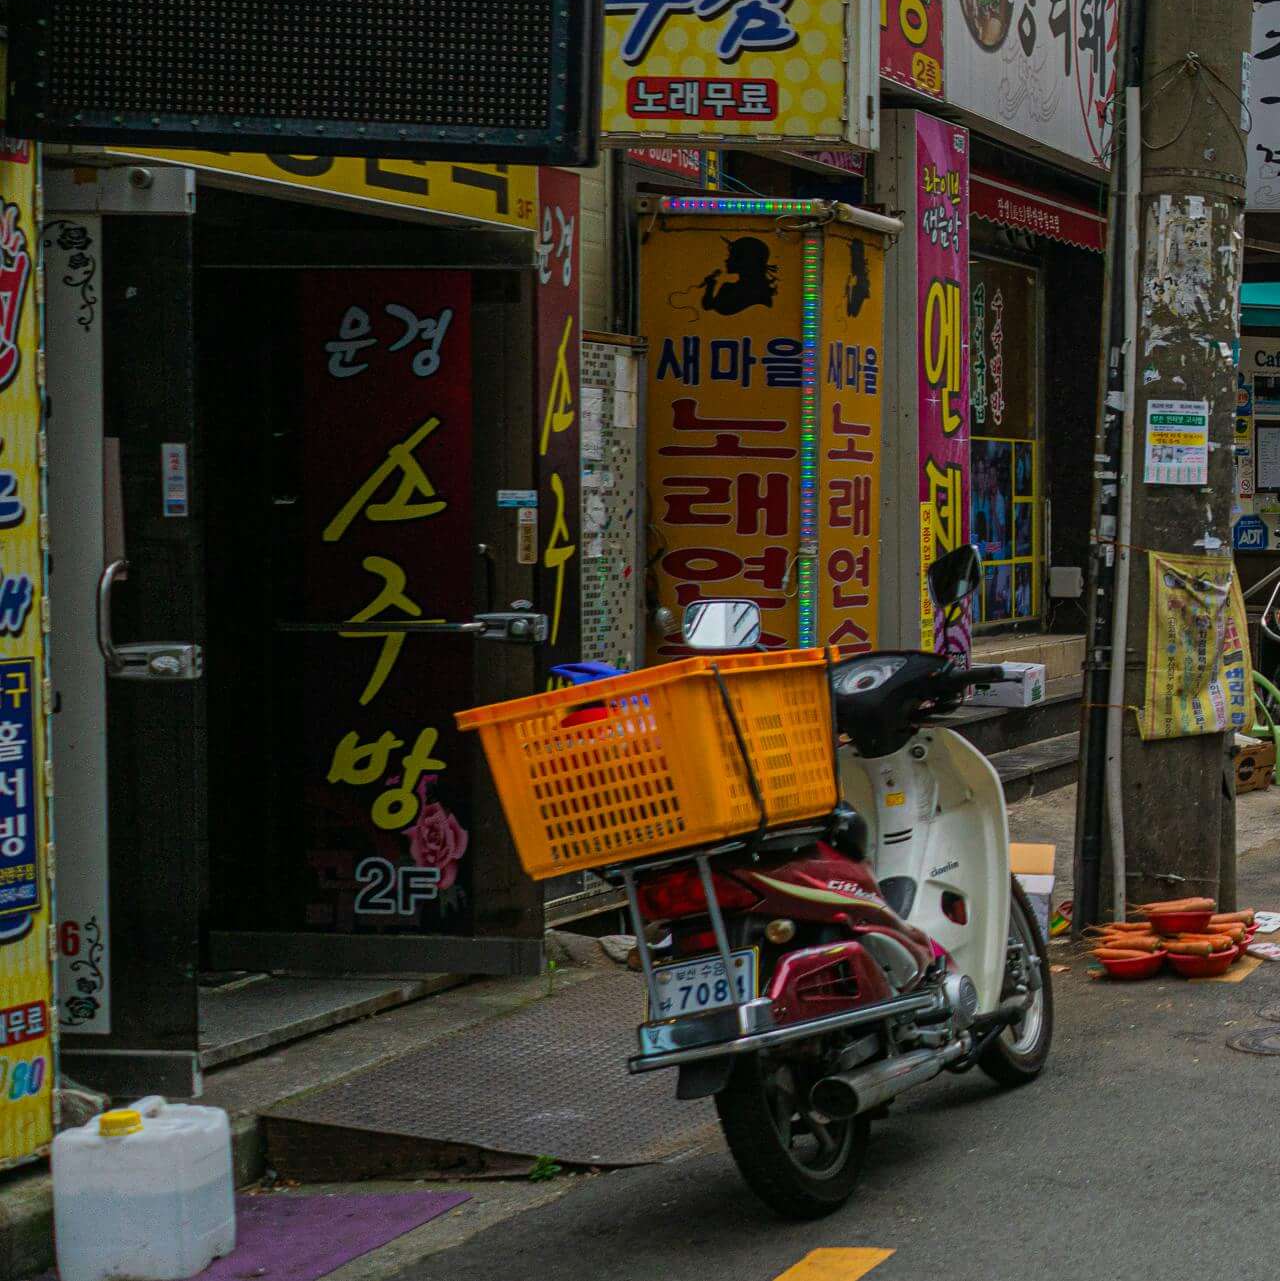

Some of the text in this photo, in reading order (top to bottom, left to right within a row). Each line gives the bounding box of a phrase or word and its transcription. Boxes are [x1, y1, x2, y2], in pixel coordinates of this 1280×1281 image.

[632, 82, 772, 118] 노래무료
[656, 337, 803, 389] 새마을
[827, 340, 879, 396] 새마을
[1238, 528, 1264, 547] ADT
[354, 857, 440, 916] 2F
